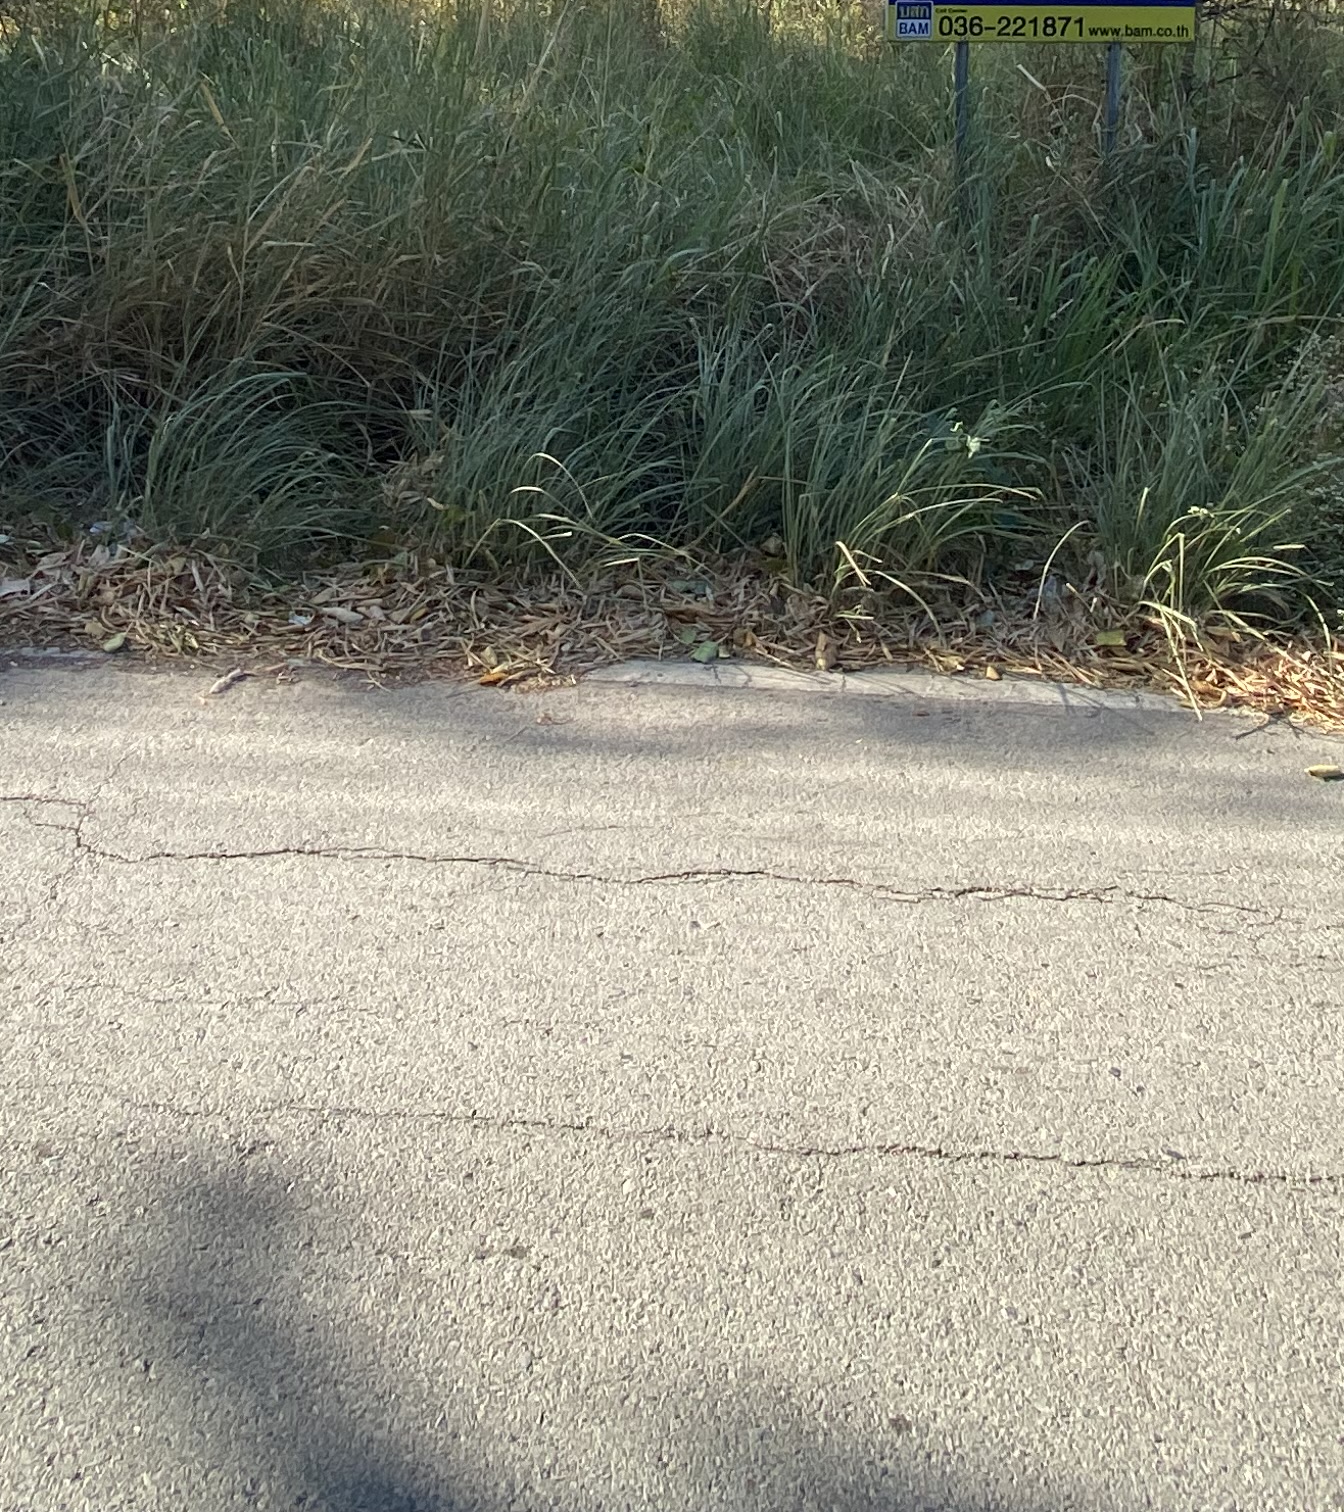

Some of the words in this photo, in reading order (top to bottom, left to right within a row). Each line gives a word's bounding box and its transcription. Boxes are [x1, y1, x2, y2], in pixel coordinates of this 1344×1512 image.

[899, 22, 929, 34] BAM
[938, 16, 1085, 37] 036-221871
[1088, 24, 1189, 38] www.bam.co.th
